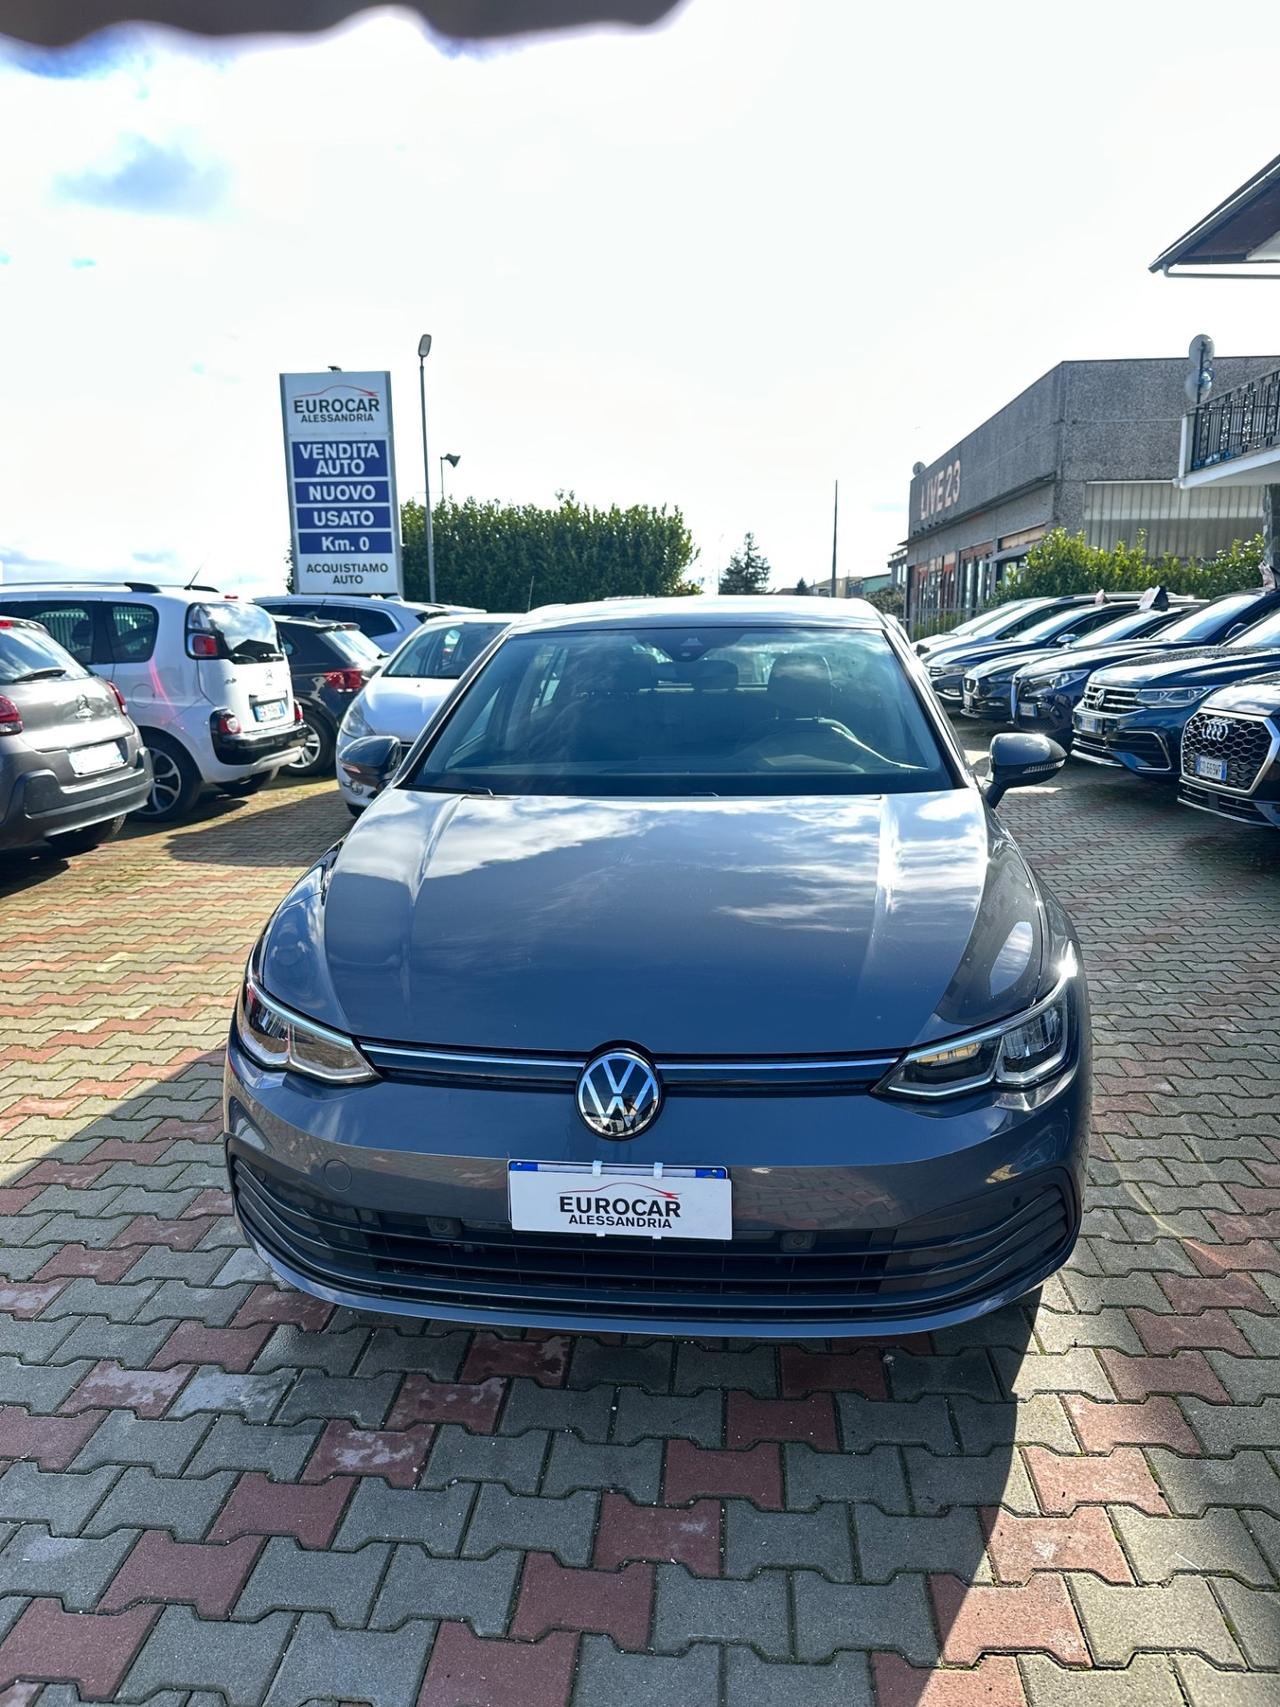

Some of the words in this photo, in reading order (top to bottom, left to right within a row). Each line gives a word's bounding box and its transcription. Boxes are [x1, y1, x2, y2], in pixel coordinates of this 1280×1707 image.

[294, 398, 380, 413] EUROCAR
[300, 413, 374, 423] ALESSANDRIA
[299, 443, 380, 459] VENDITA
[316, 459, 365, 475] AUTO
[308, 485, 376, 501] NUOVO
[920, 470, 945, 520] LIVE
[944, 460, 961, 507] 23
[313, 510, 375, 526] USATO
[321, 536, 355, 551] Km.
[359, 536, 370, 551] 0
[306, 563, 389, 573] ACQUISTIAMO
[332, 574, 364, 585] AUTO
[559, 1196, 681, 1217] EUROCAR
[568, 1214, 673, 1229] ALESSANDRIA
